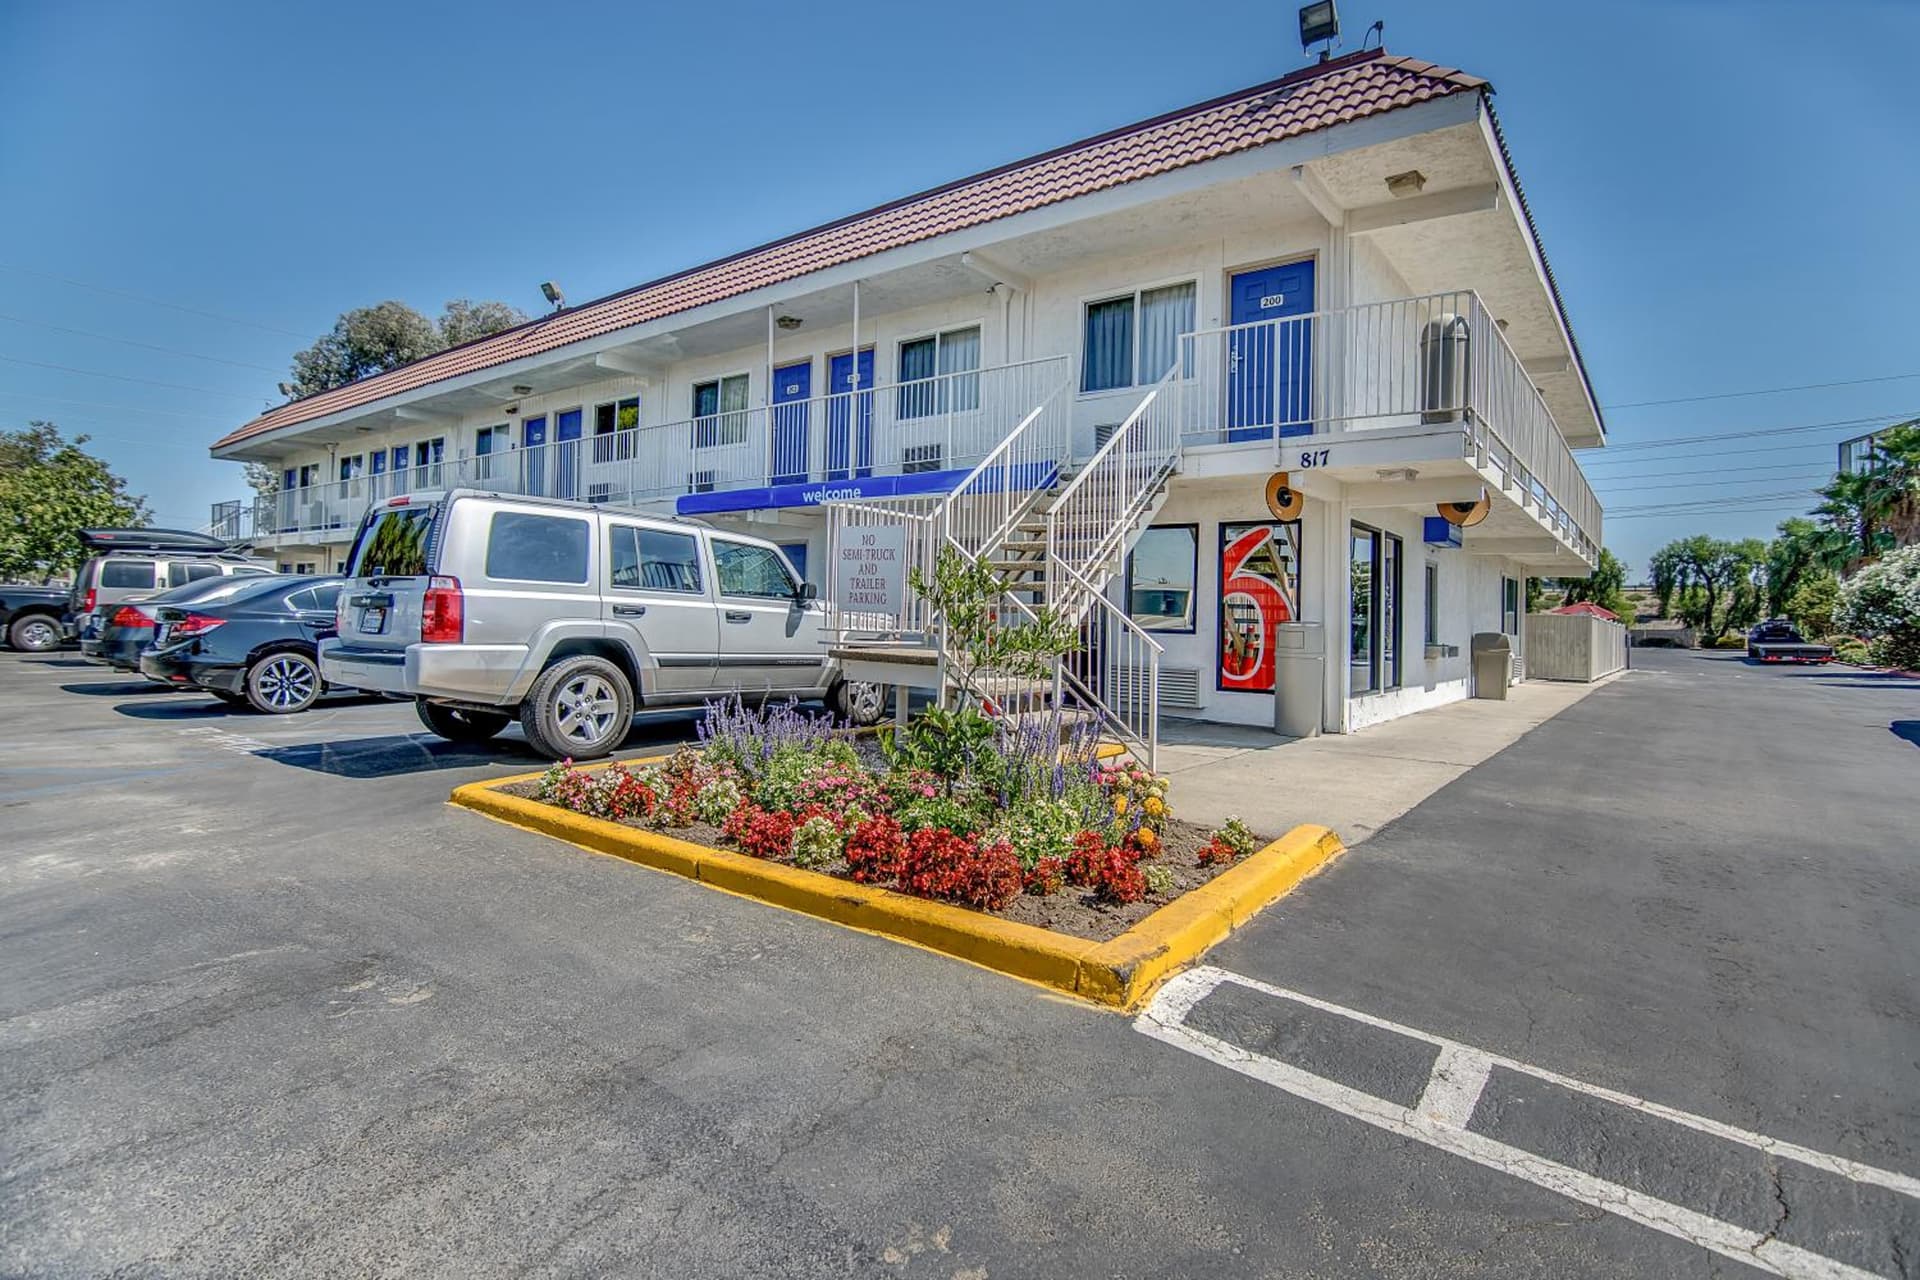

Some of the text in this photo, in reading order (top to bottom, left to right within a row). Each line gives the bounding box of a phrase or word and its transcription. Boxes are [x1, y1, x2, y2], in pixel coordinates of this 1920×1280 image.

[1263, 296, 1281, 306] 200
[1301, 449, 1330, 468] 817
[802, 485, 861, 503] welcome
[862, 534, 875, 546] NO
[842, 548, 896, 561] SEMI-TRUCK
[858, 563, 878, 575] AND
[850, 577, 886, 590] TRAILER
[848, 592, 887, 604] PARKING
